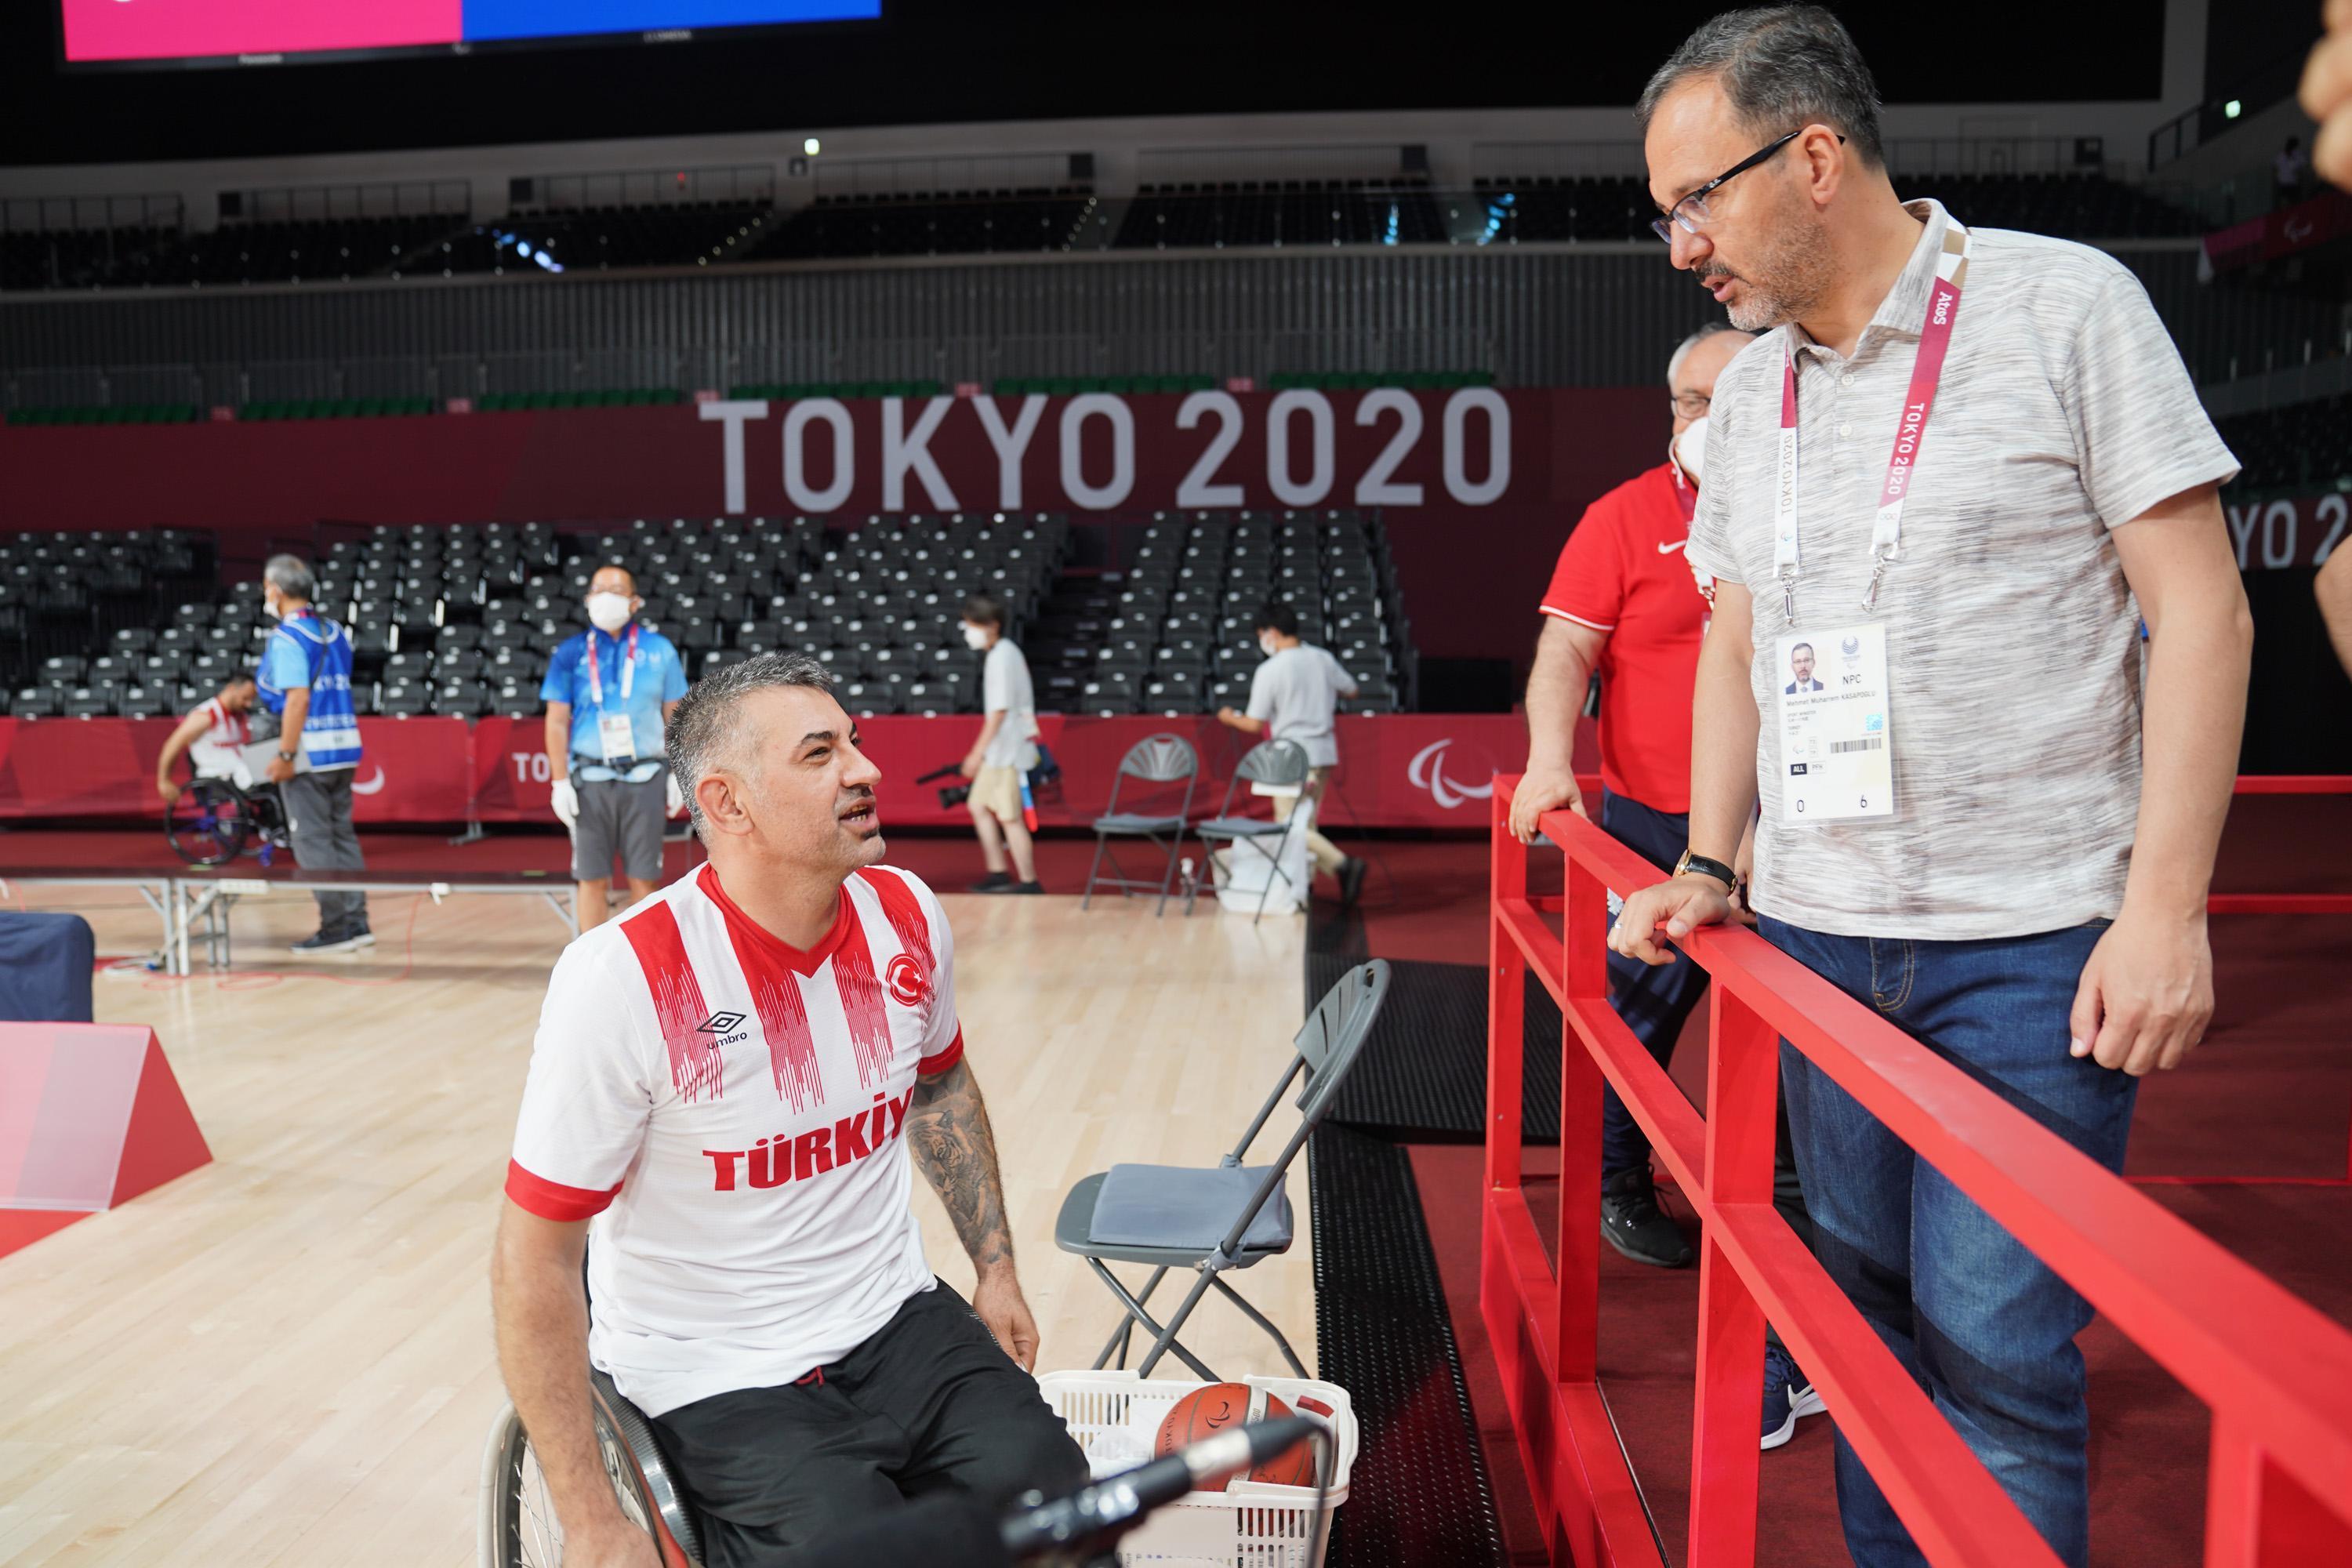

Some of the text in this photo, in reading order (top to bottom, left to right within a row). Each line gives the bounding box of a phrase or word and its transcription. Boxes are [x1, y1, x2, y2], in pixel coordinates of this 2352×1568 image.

[1933, 291, 1952, 325] Atos
[699, 387, 1511, 514] TOKYO 2020
[1888, 402, 1925, 495] TOKYO 2020
[1781, 434, 1792, 516] TOKYO 2020
[2228, 499, 2297, 571] YO
[1842, 674, 1861, 684] NPC
[1811, 695, 1839, 703] Muharrem
[512, 752, 550, 782] TO
[1797, 794, 1867, 812] 0 6
[708, 1032, 747, 1050] umbro
[702, 1085, 914, 1191] TÜRKİY
